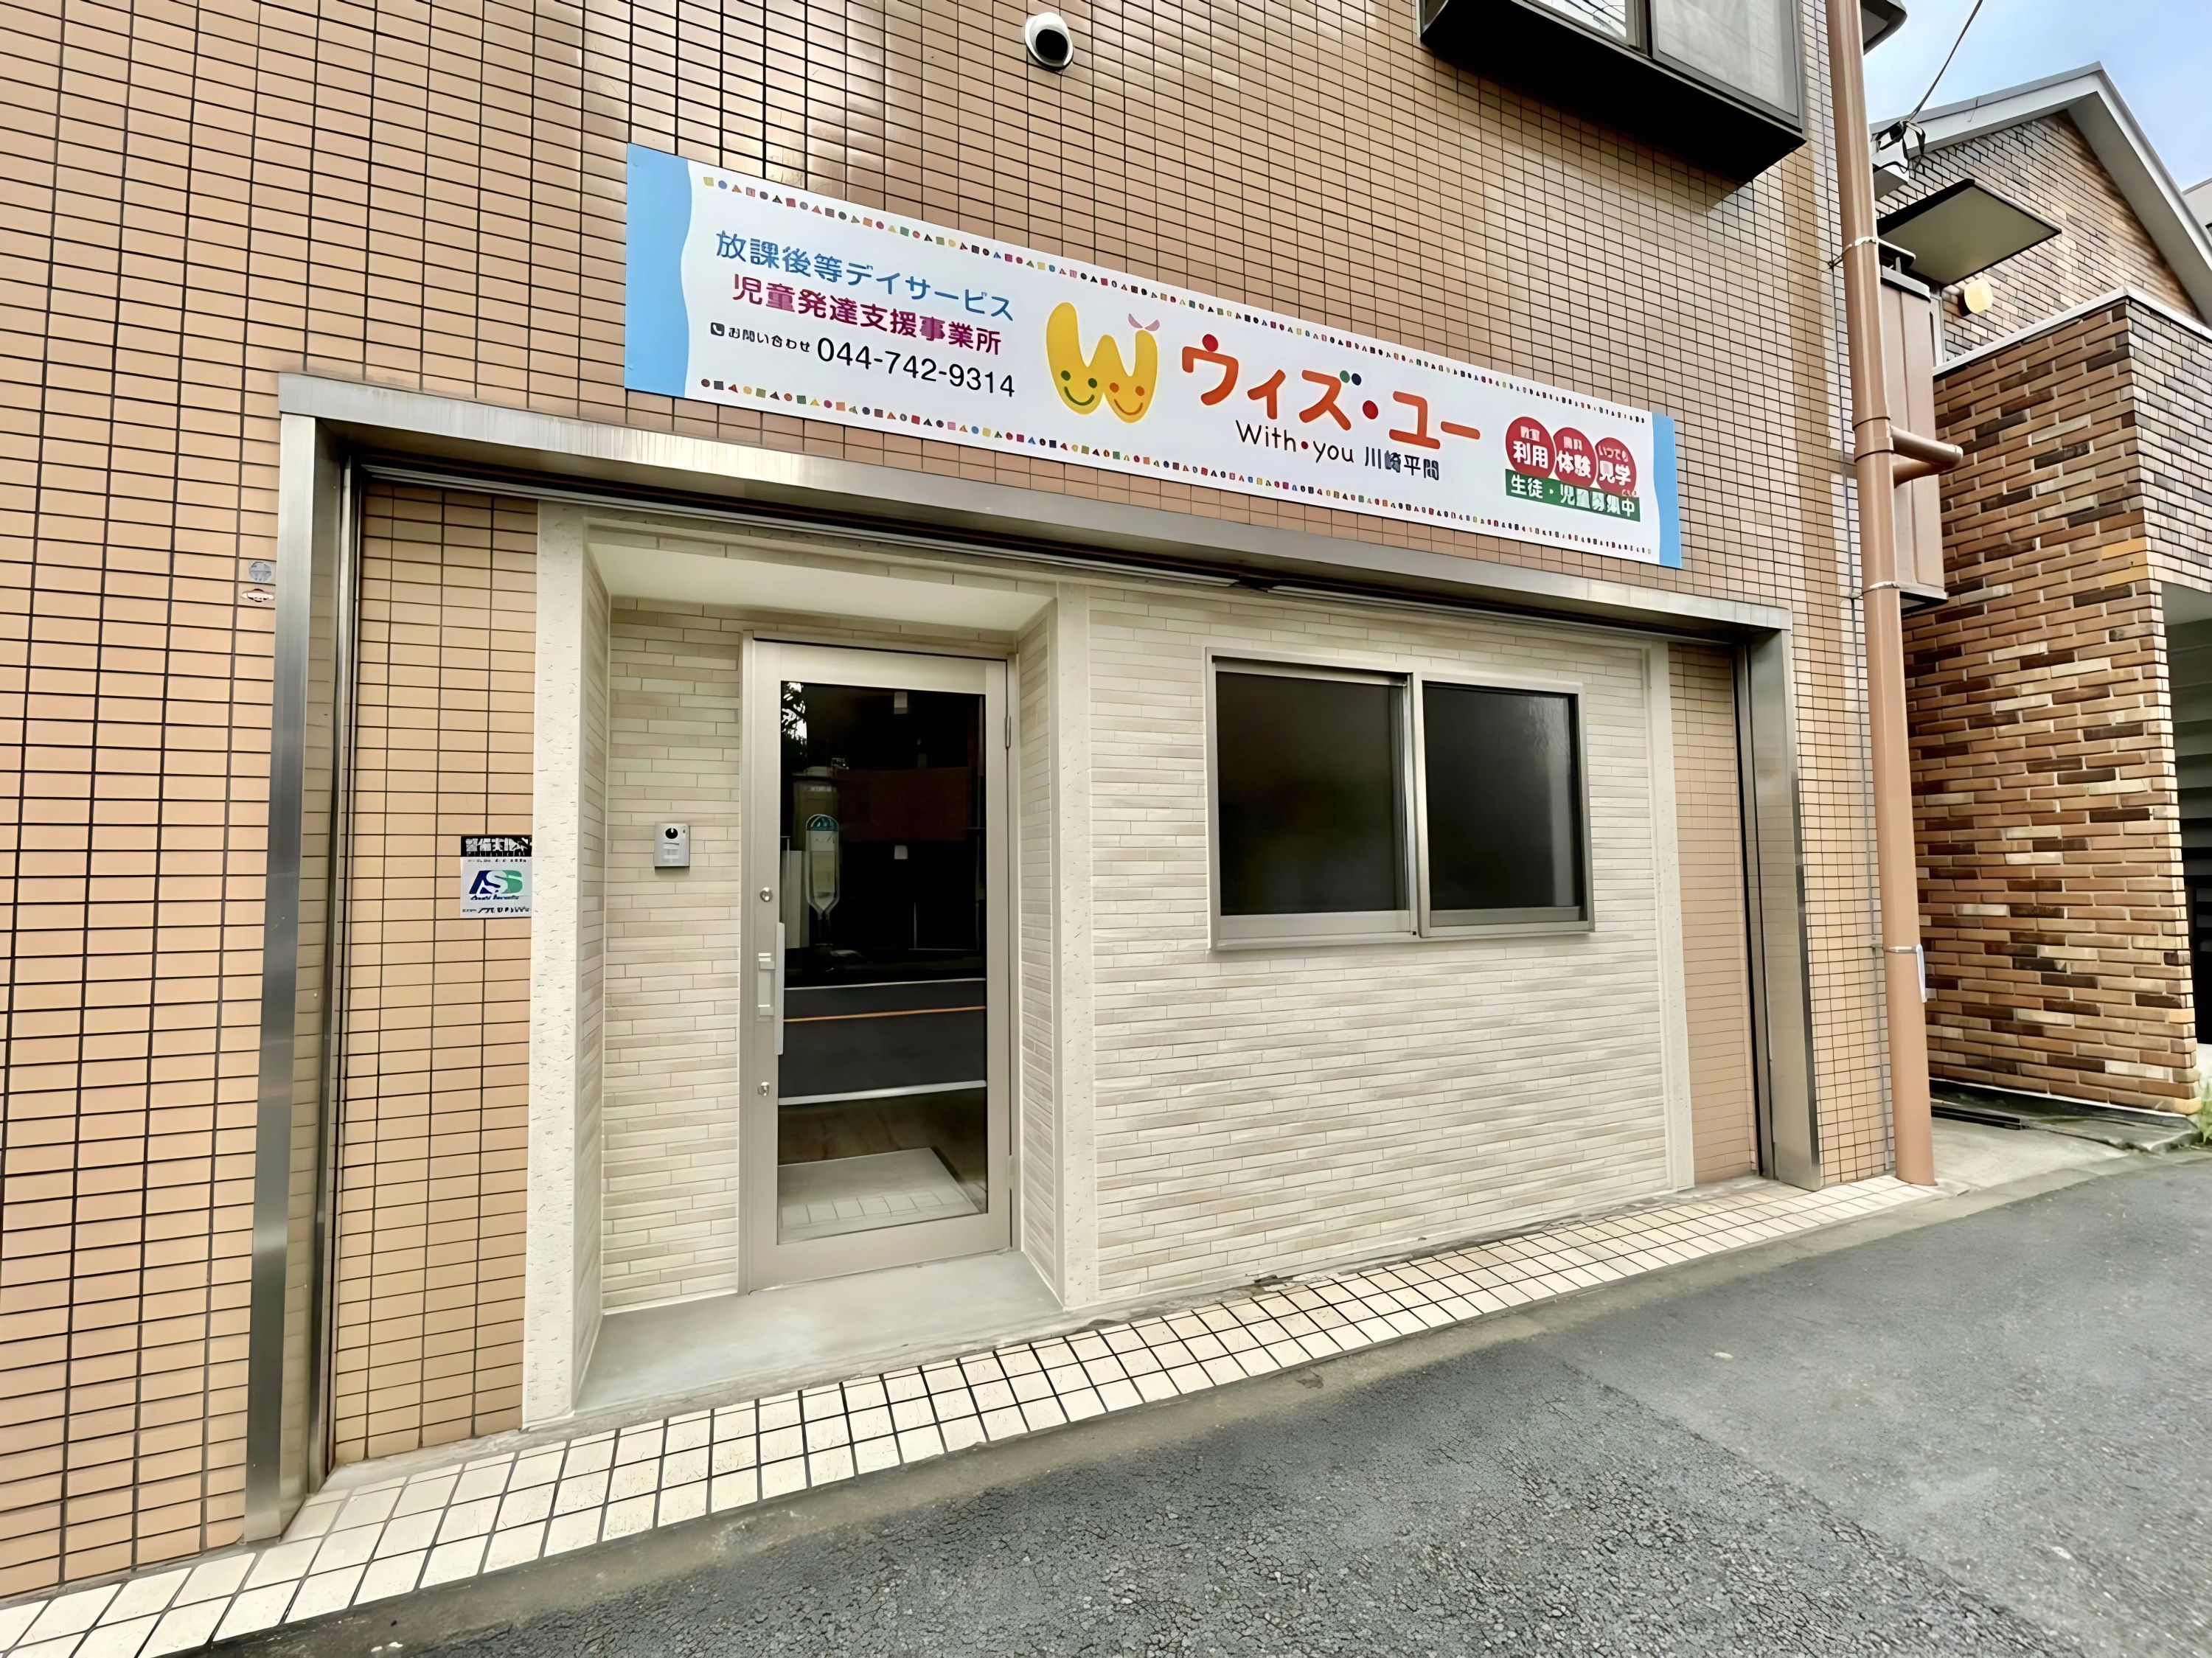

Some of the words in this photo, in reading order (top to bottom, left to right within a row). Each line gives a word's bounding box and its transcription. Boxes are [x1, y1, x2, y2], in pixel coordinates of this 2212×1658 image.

[716, 231, 1013, 321] 放課後等デイサービス
[733, 274, 1001, 355] 児童発達支援事業所
[728, 327, 810, 352] お問い合わせ
[817, 337, 1015, 397] 044-742-9314
[1181, 333, 1481, 450] ウィズ・ユー
[1513, 440, 1548, 469] 利用
[1557, 450, 1592, 478] 体験
[1599, 460, 1632, 486] 見学
